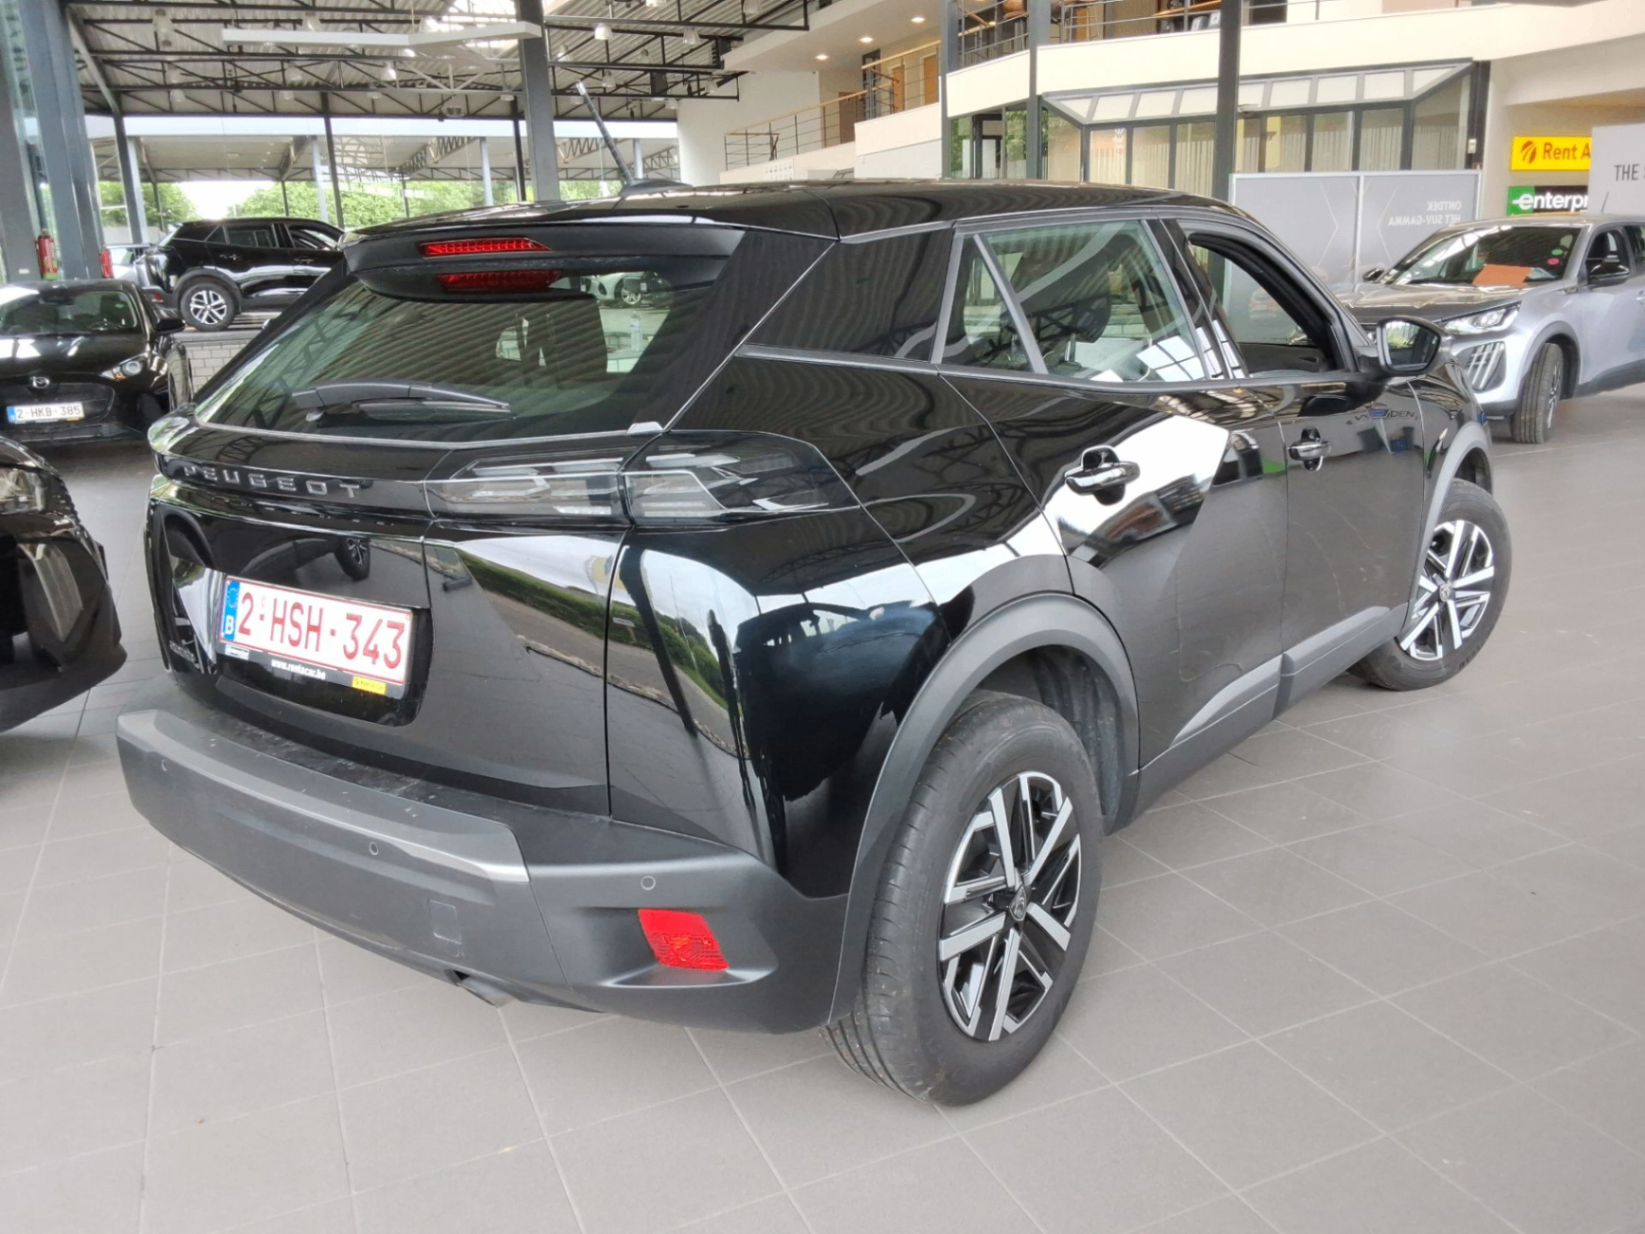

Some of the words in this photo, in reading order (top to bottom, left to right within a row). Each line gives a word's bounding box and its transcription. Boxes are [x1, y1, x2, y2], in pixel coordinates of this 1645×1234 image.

[1543, 142, 1577, 160] Rent
[1614, 163, 1640, 181] THE
[17, 405, 81, 418] 2-HKB-385
[184, 465, 360, 498] PEUGEOT
[225, 615, 234, 634] B
